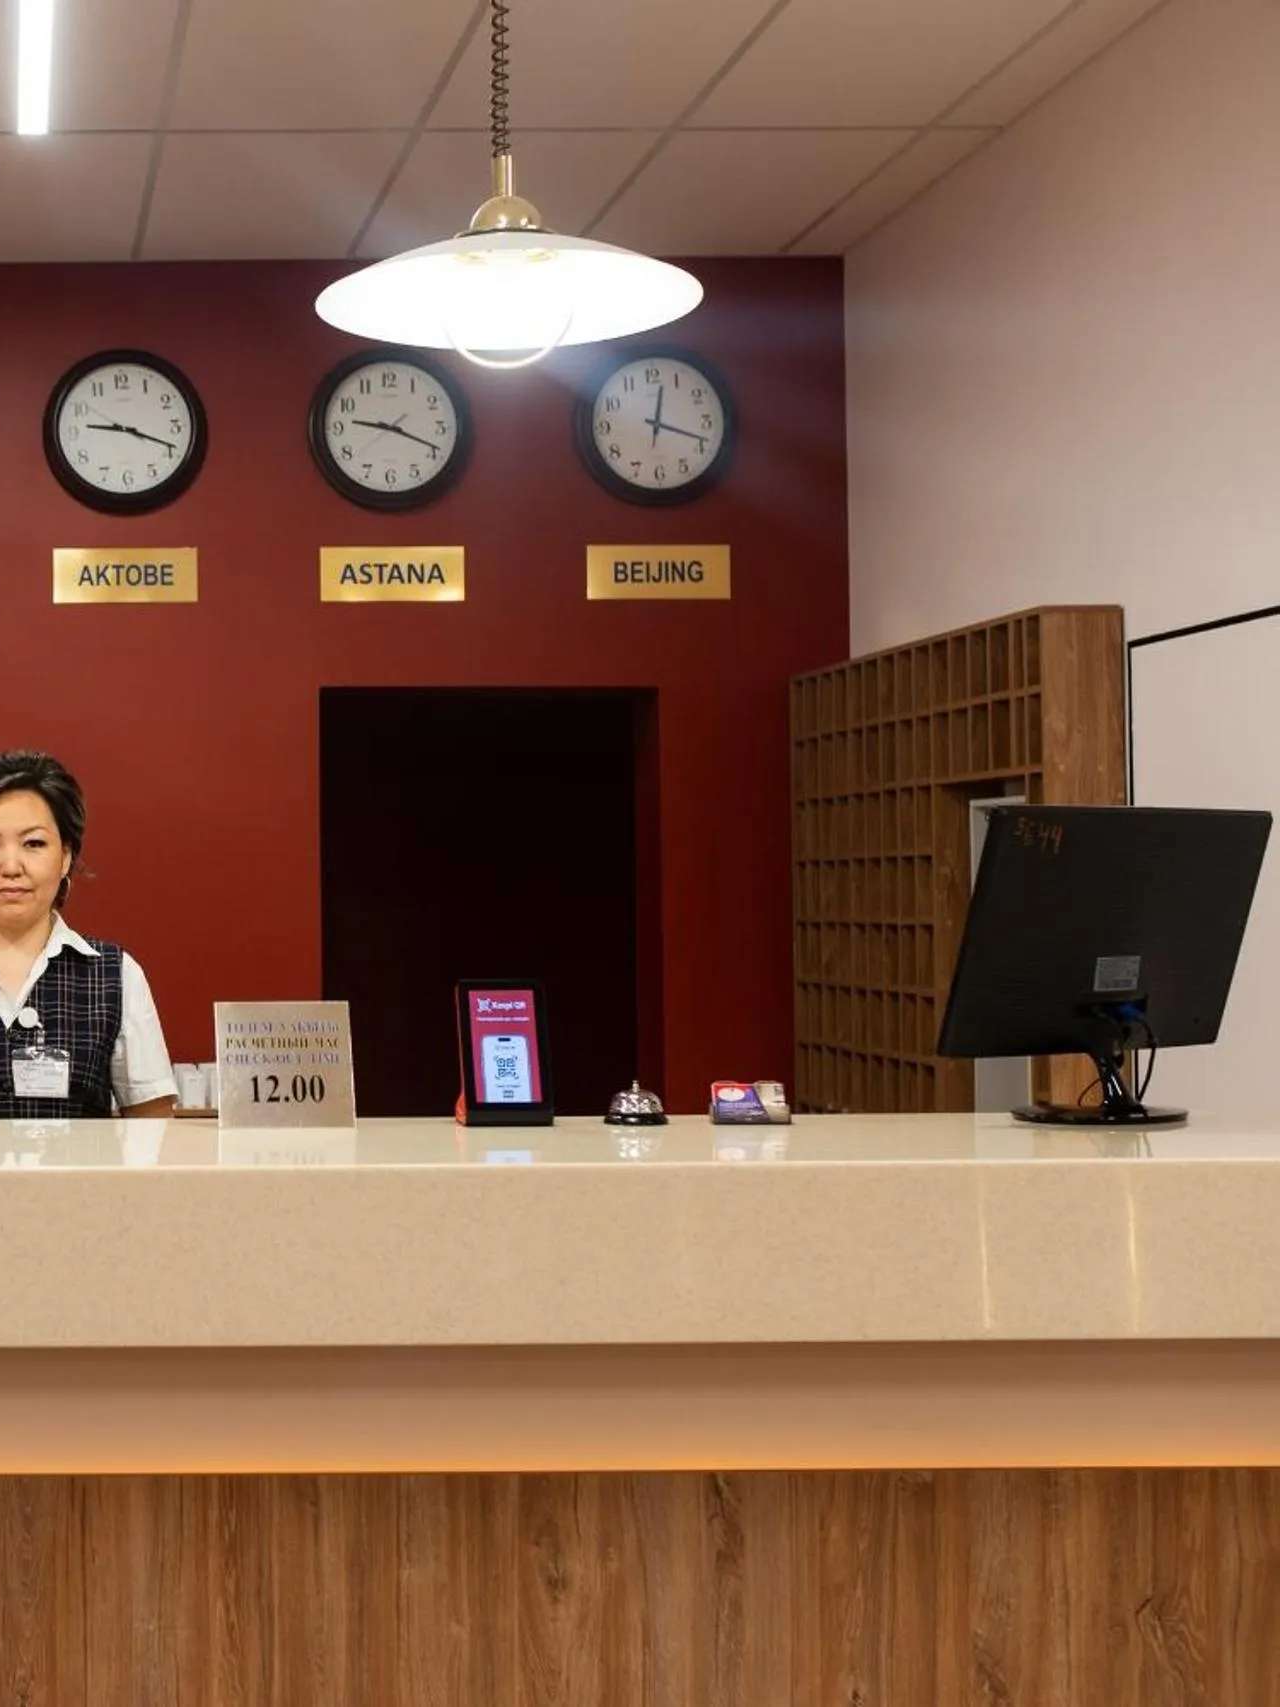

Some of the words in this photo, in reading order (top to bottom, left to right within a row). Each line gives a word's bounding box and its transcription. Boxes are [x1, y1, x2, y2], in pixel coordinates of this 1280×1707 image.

[114, 374, 129, 389] 12
[382, 372, 397, 387] 12
[645, 368, 660, 383] 12
[675, 373, 678, 388] 1
[92, 382, 103, 396] 11
[143, 379, 147, 393] 1
[360, 379, 370, 394] 11
[410, 378, 414, 393] 1
[624, 376, 634, 392] 11
[161, 394, 170, 409] 2
[427, 395, 437, 410] 2
[691, 389, 702, 404] 2
[74, 401, 88, 417] 10
[341, 397, 355, 412] 10
[606, 397, 619, 412] 10
[171, 419, 181, 434] 3
[333, 421, 344, 436] 9
[435, 421, 446, 435] 3
[600, 421, 610, 435] 9
[702, 414, 712, 429] 3
[69, 426, 79, 440] 9
[78, 449, 88, 464] 8
[342, 446, 352, 460] 8
[609, 444, 620, 459] 8
[147, 464, 157, 478] 5
[362, 464, 372, 478] 7
[409, 464, 419, 478] 5
[631, 461, 641, 476] 7
[655, 465, 665, 480] 6
[679, 458, 688, 473] 5
[99, 467, 109, 481] 7
[123, 471, 134, 485] 6
[385, 470, 396, 484] 6
[78, 564, 174, 586] AKTOBE
[340, 563, 445, 584] ASTANA
[613, 561, 704, 583] BEIJING
[250, 1074, 325, 1103] 12.00
